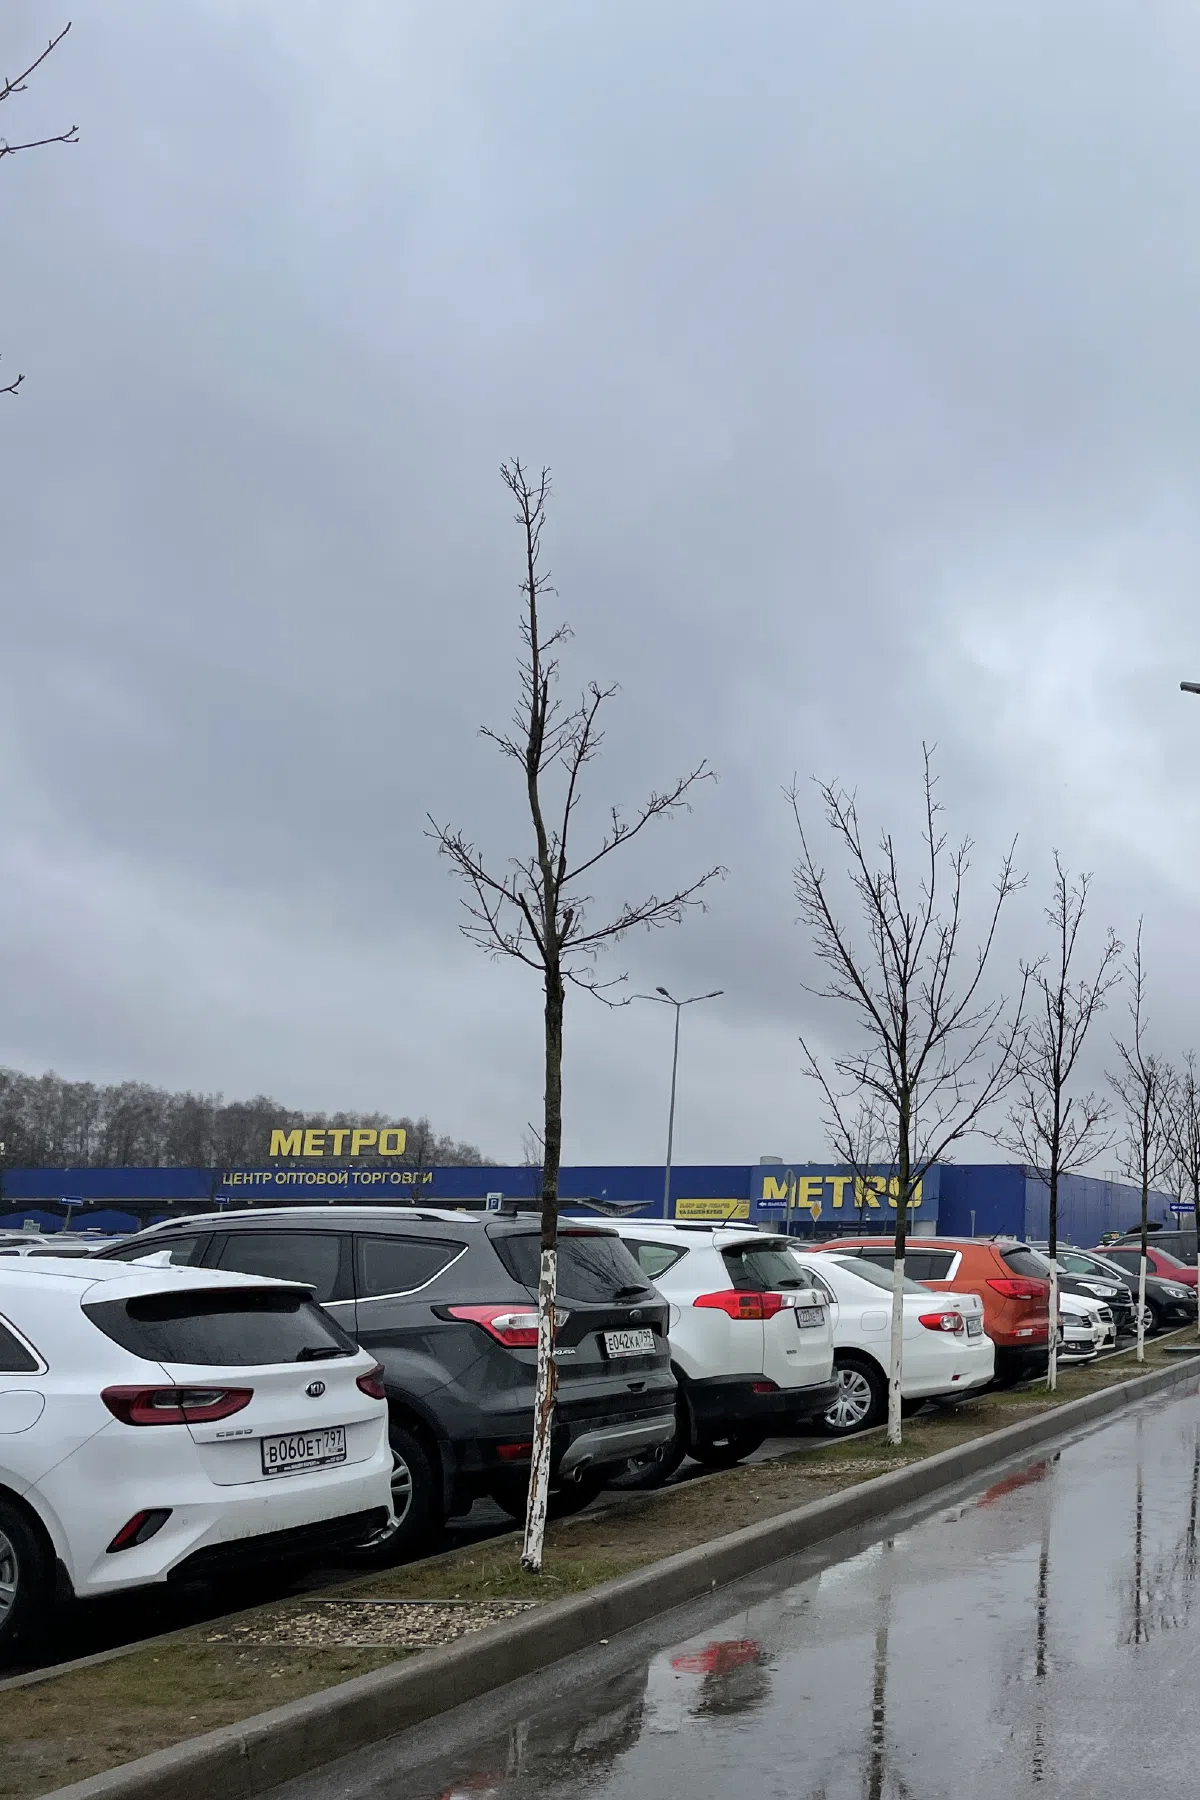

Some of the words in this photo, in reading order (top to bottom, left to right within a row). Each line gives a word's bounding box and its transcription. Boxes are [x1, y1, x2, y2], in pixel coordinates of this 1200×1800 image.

[269, 1128, 407, 1156] МЕТРО
[222, 1172, 272, 1186] ЦЕНТР
[275, 1170, 348, 1184] ОПТОВОЙ
[762, 1176, 923, 1208] METRO
[310, 1383, 324, 1394] KIA
[324, 1430, 341, 1447] 797
